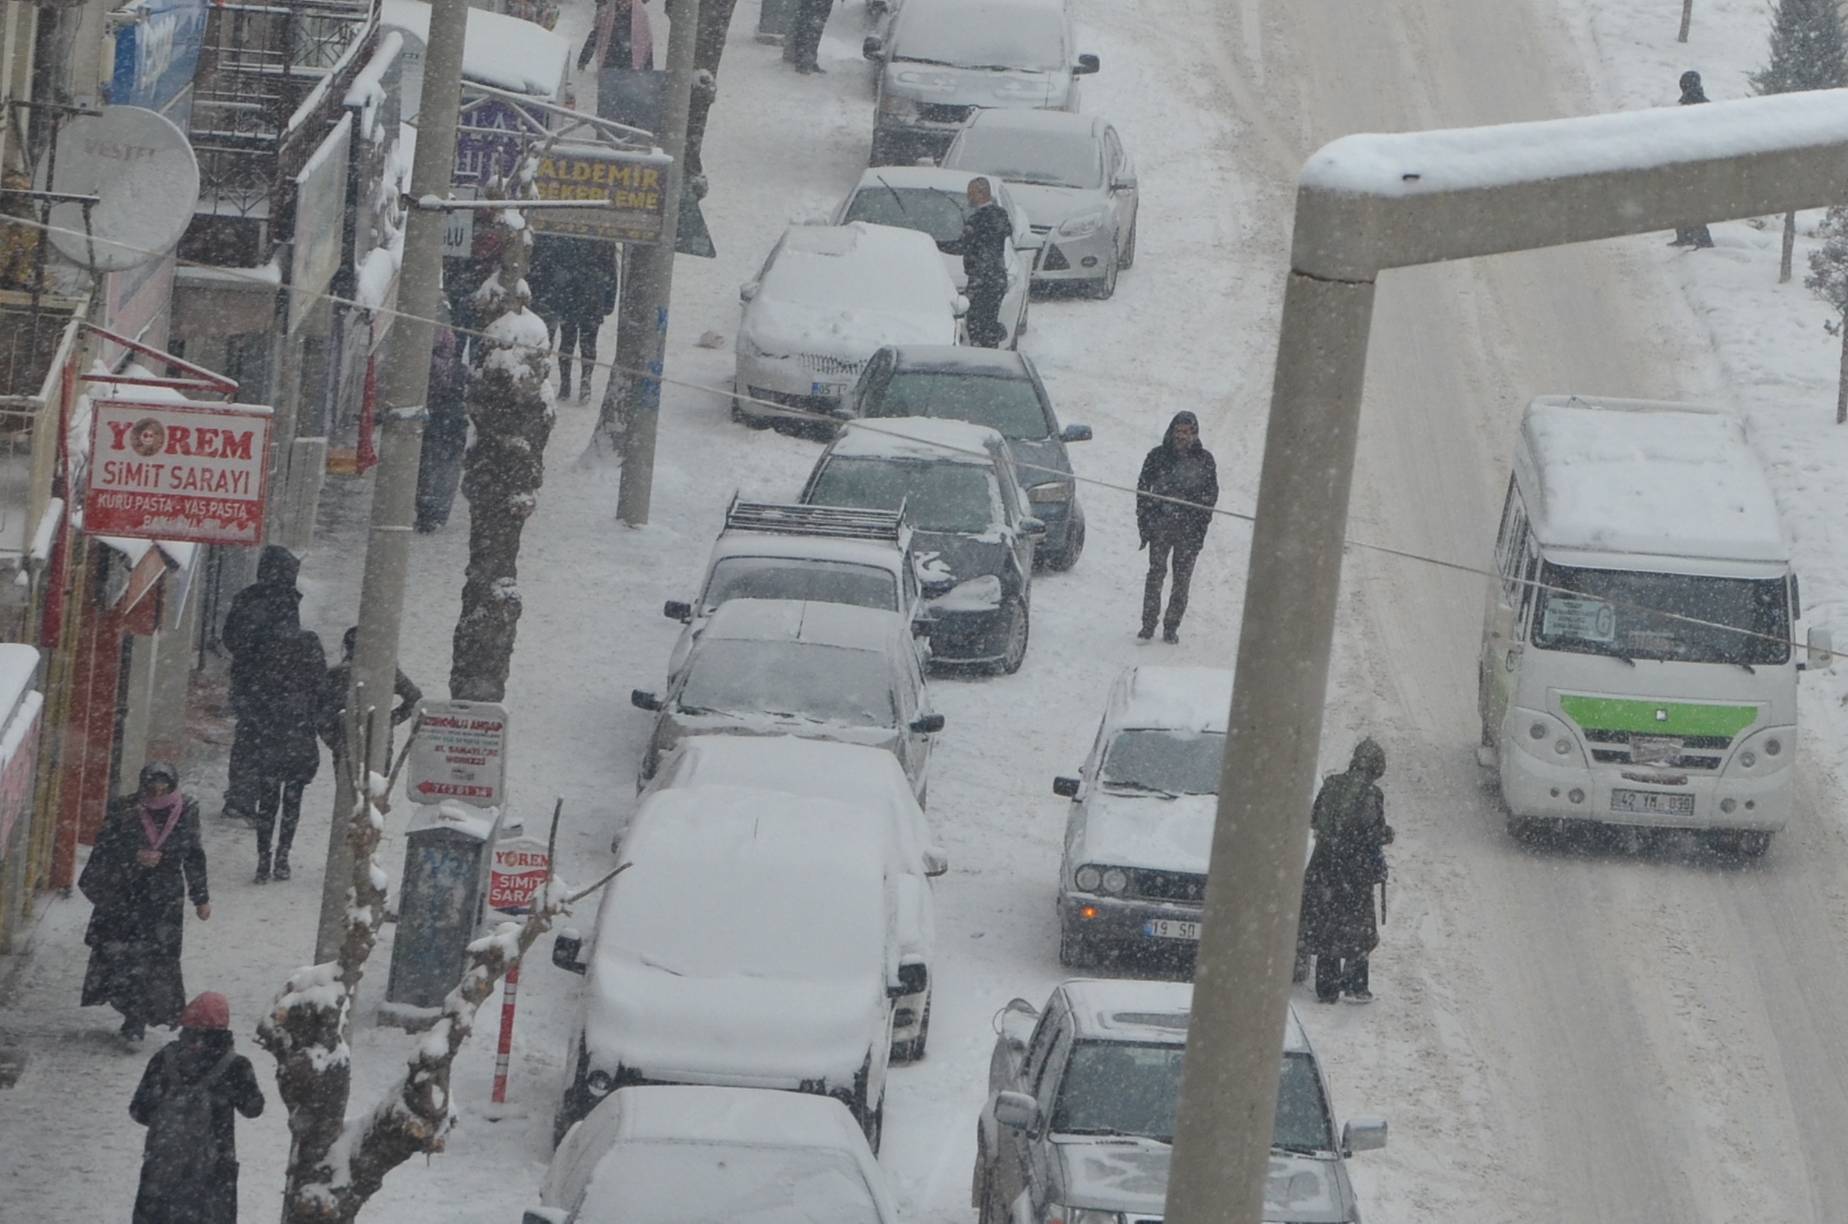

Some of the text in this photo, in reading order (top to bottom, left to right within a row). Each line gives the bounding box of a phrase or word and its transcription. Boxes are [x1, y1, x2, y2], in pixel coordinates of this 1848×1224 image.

[537, 158, 659, 190] ALDEMİR
[103, 461, 250, 495] SİMİT SARAYI
[98, 493, 132, 510] KURU
[135, 496, 173, 513] PASTA
[209, 503, 248, 519] PASTA
[1621, 793, 1636, 806] 42
[1643, 795, 1657, 808] YM
[499, 876, 544, 889] SİMİT
[492, 889, 534, 902] SARA
[1154, 922, 1167, 936] 19
